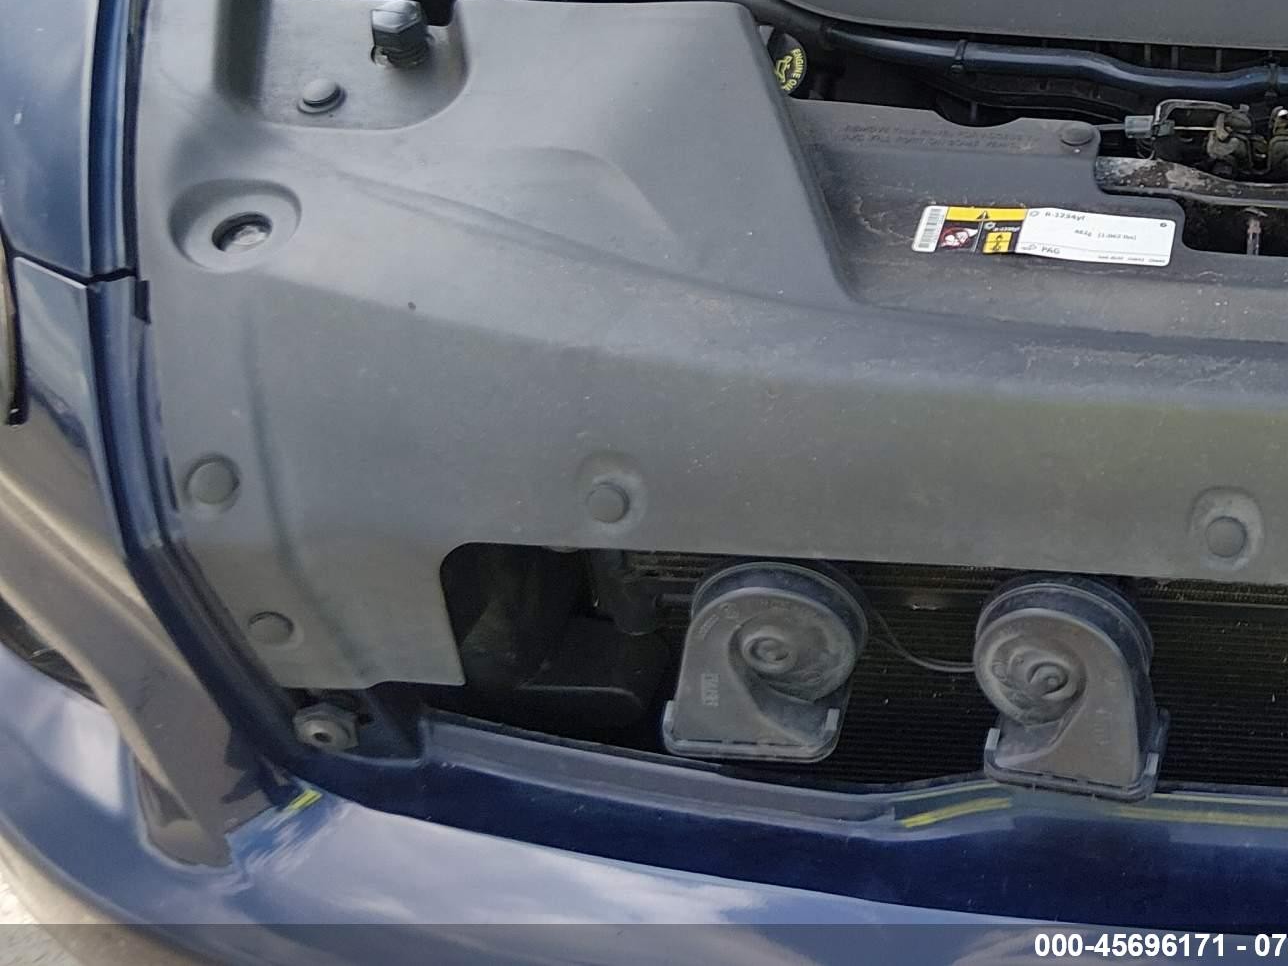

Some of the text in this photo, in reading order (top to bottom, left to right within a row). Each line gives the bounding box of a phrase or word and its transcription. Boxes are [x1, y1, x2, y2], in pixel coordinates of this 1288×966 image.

[781, 48, 804, 91] ENGINE OIL
[1041, 246, 1060, 255] PAG
